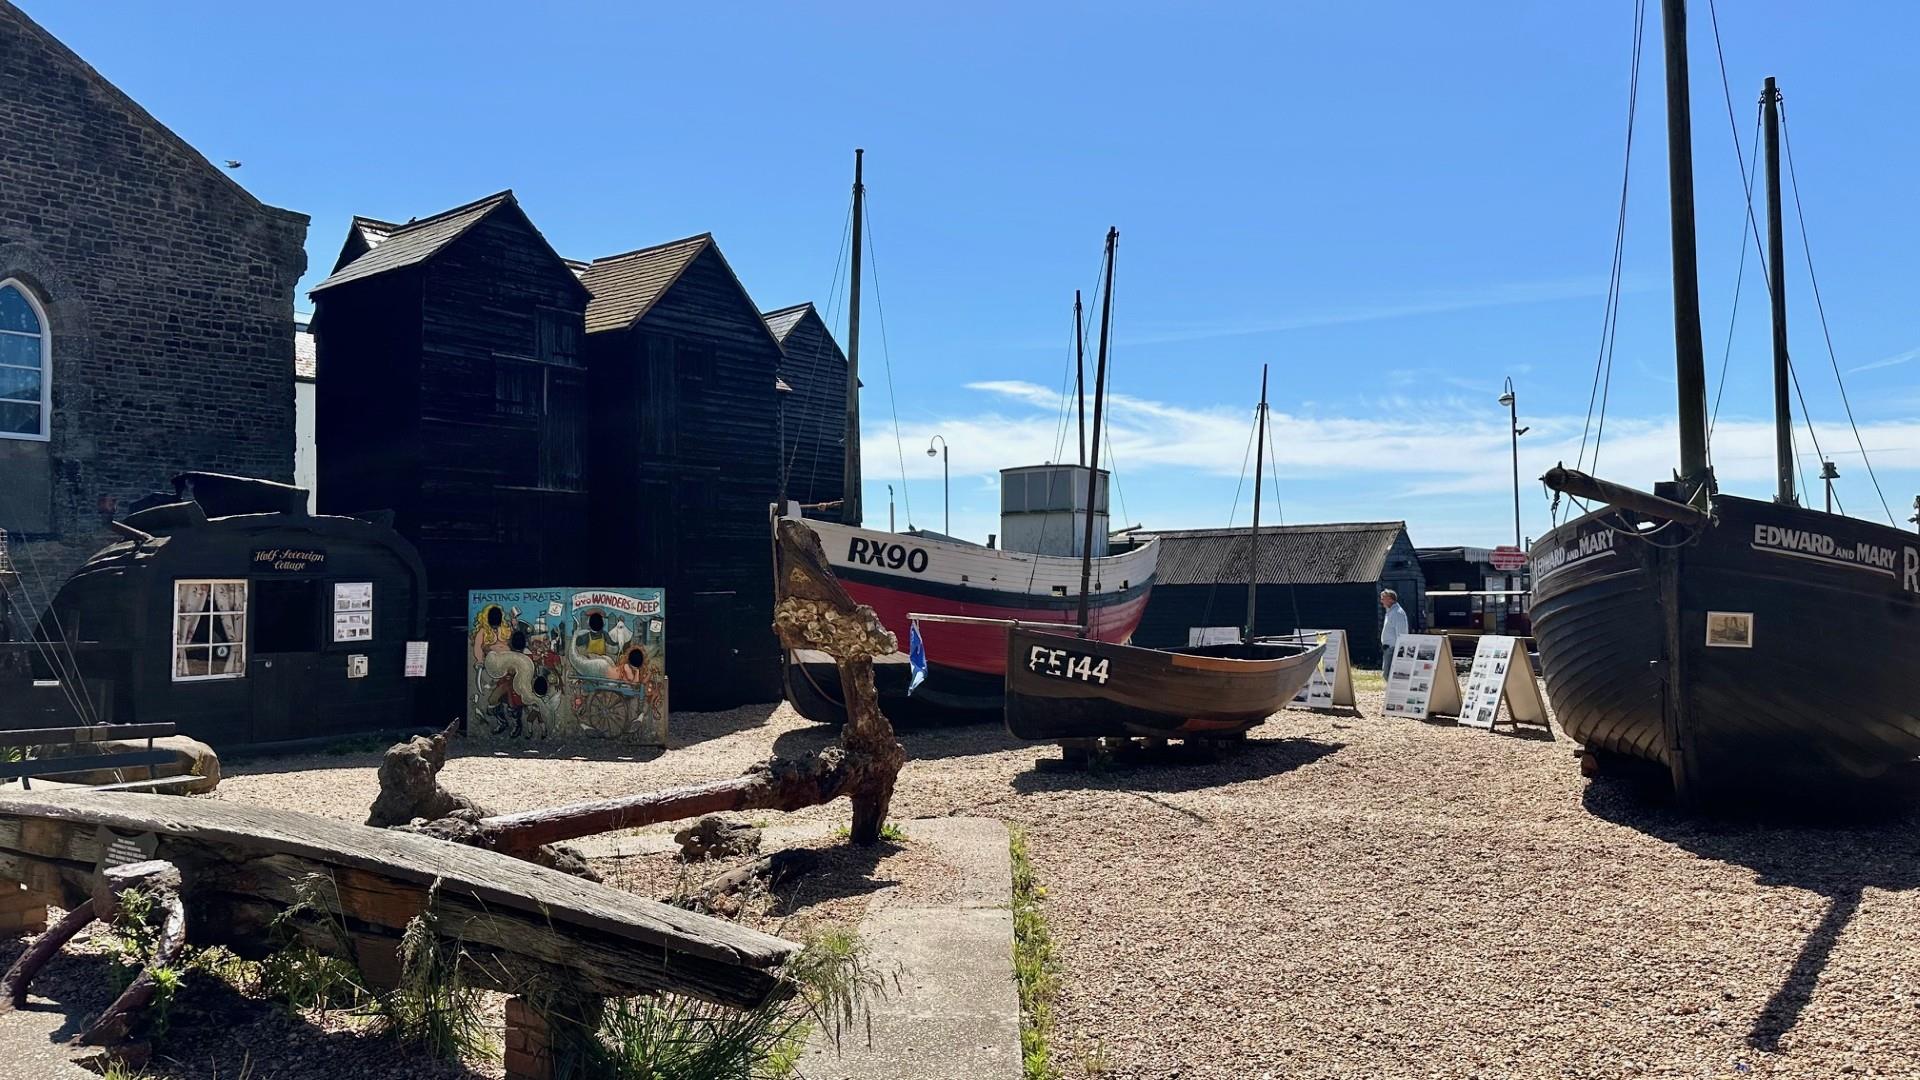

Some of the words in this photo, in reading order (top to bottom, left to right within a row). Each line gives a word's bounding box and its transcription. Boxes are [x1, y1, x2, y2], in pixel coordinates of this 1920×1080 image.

[255, 549, 280, 561] Half
[280, 549, 324, 561] Sovereign
[847, 536, 929, 573] RX90
[1566, 549, 1579, 562] AND
[1579, 529, 1614, 557] MARY
[1754, 524, 1834, 555] EDWARD
[1834, 547, 1855, 560] AND
[1856, 542, 1897, 569] MARY
[274, 560, 305, 571] Cottage
[1904, 545, 1920, 594] R
[473, 592, 520, 604] HASTINGS
[523, 592, 561, 603] PIRATES
[592, 593, 632, 610] WONDERS
[637, 601, 660, 613] DEEP
